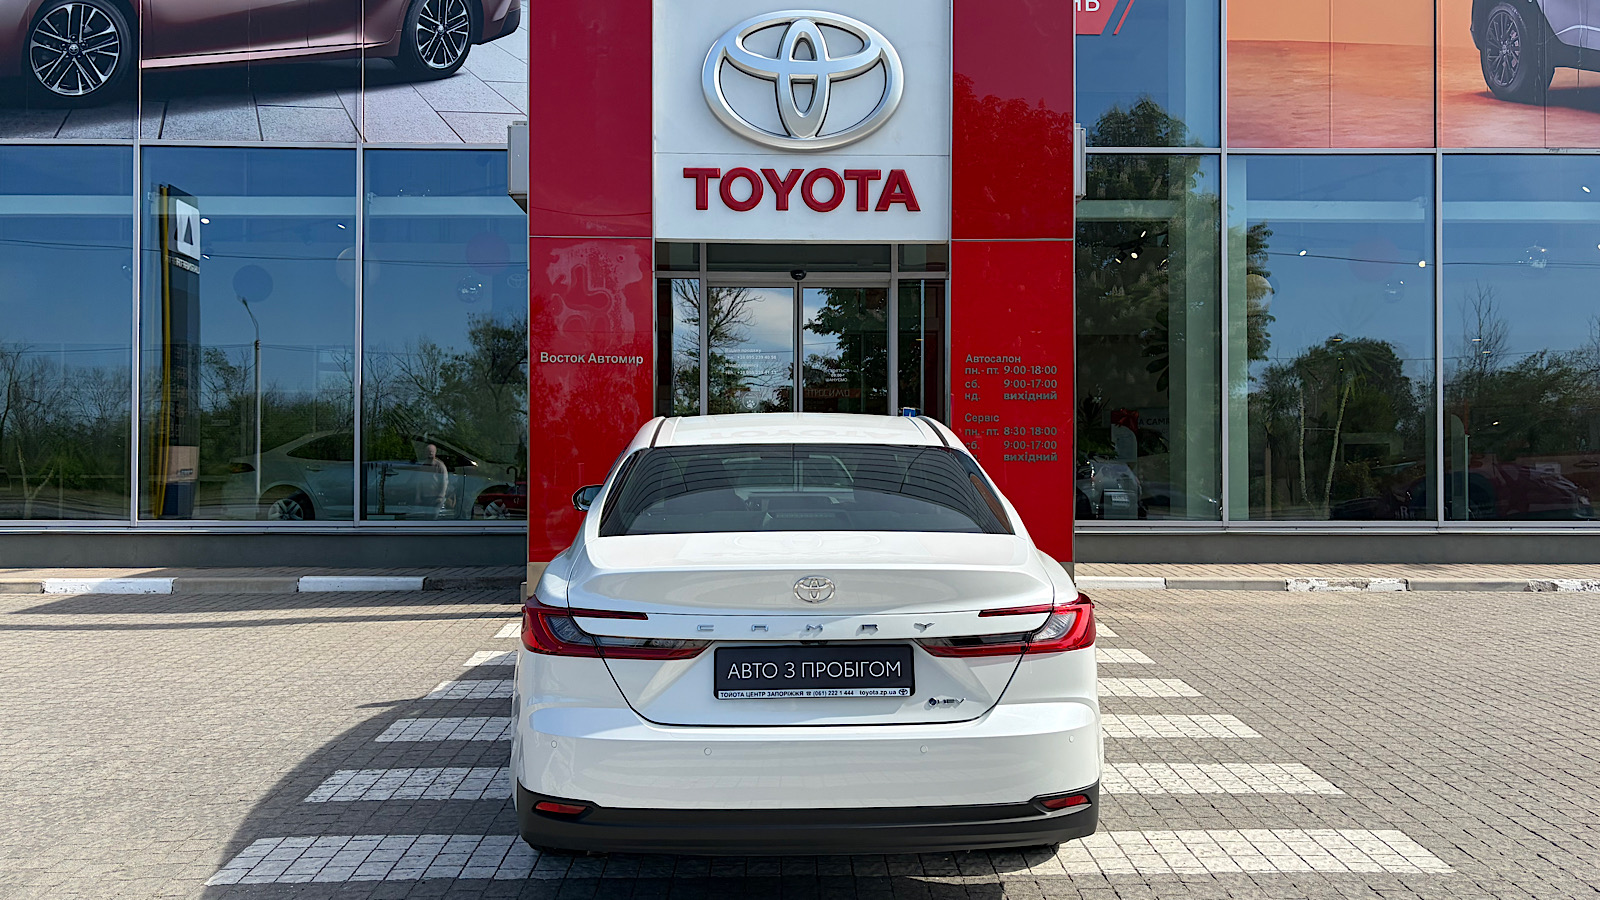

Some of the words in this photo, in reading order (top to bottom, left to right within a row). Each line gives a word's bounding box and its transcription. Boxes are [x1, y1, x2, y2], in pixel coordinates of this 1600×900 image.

[683, 167, 920, 212] TOYOTA
[540, 352, 586, 363] Восток
[588, 352, 644, 366] Автомир
[965, 354, 1022, 363] Автосалон
[1004, 366, 1057, 375] 9:00-18:00
[965, 380, 980, 388] сб.
[1004, 380, 1057, 388] 9:00-17:00
[1004, 391, 1057, 401] вихідний
[965, 413, 1000, 424] Сервіс
[1004, 441, 1057, 450] 9:00-17:00
[1004, 452, 1058, 462] вихідний
[727, 662, 778, 679] АВТО
[802, 661, 901, 678] ПРОБІГОМ
